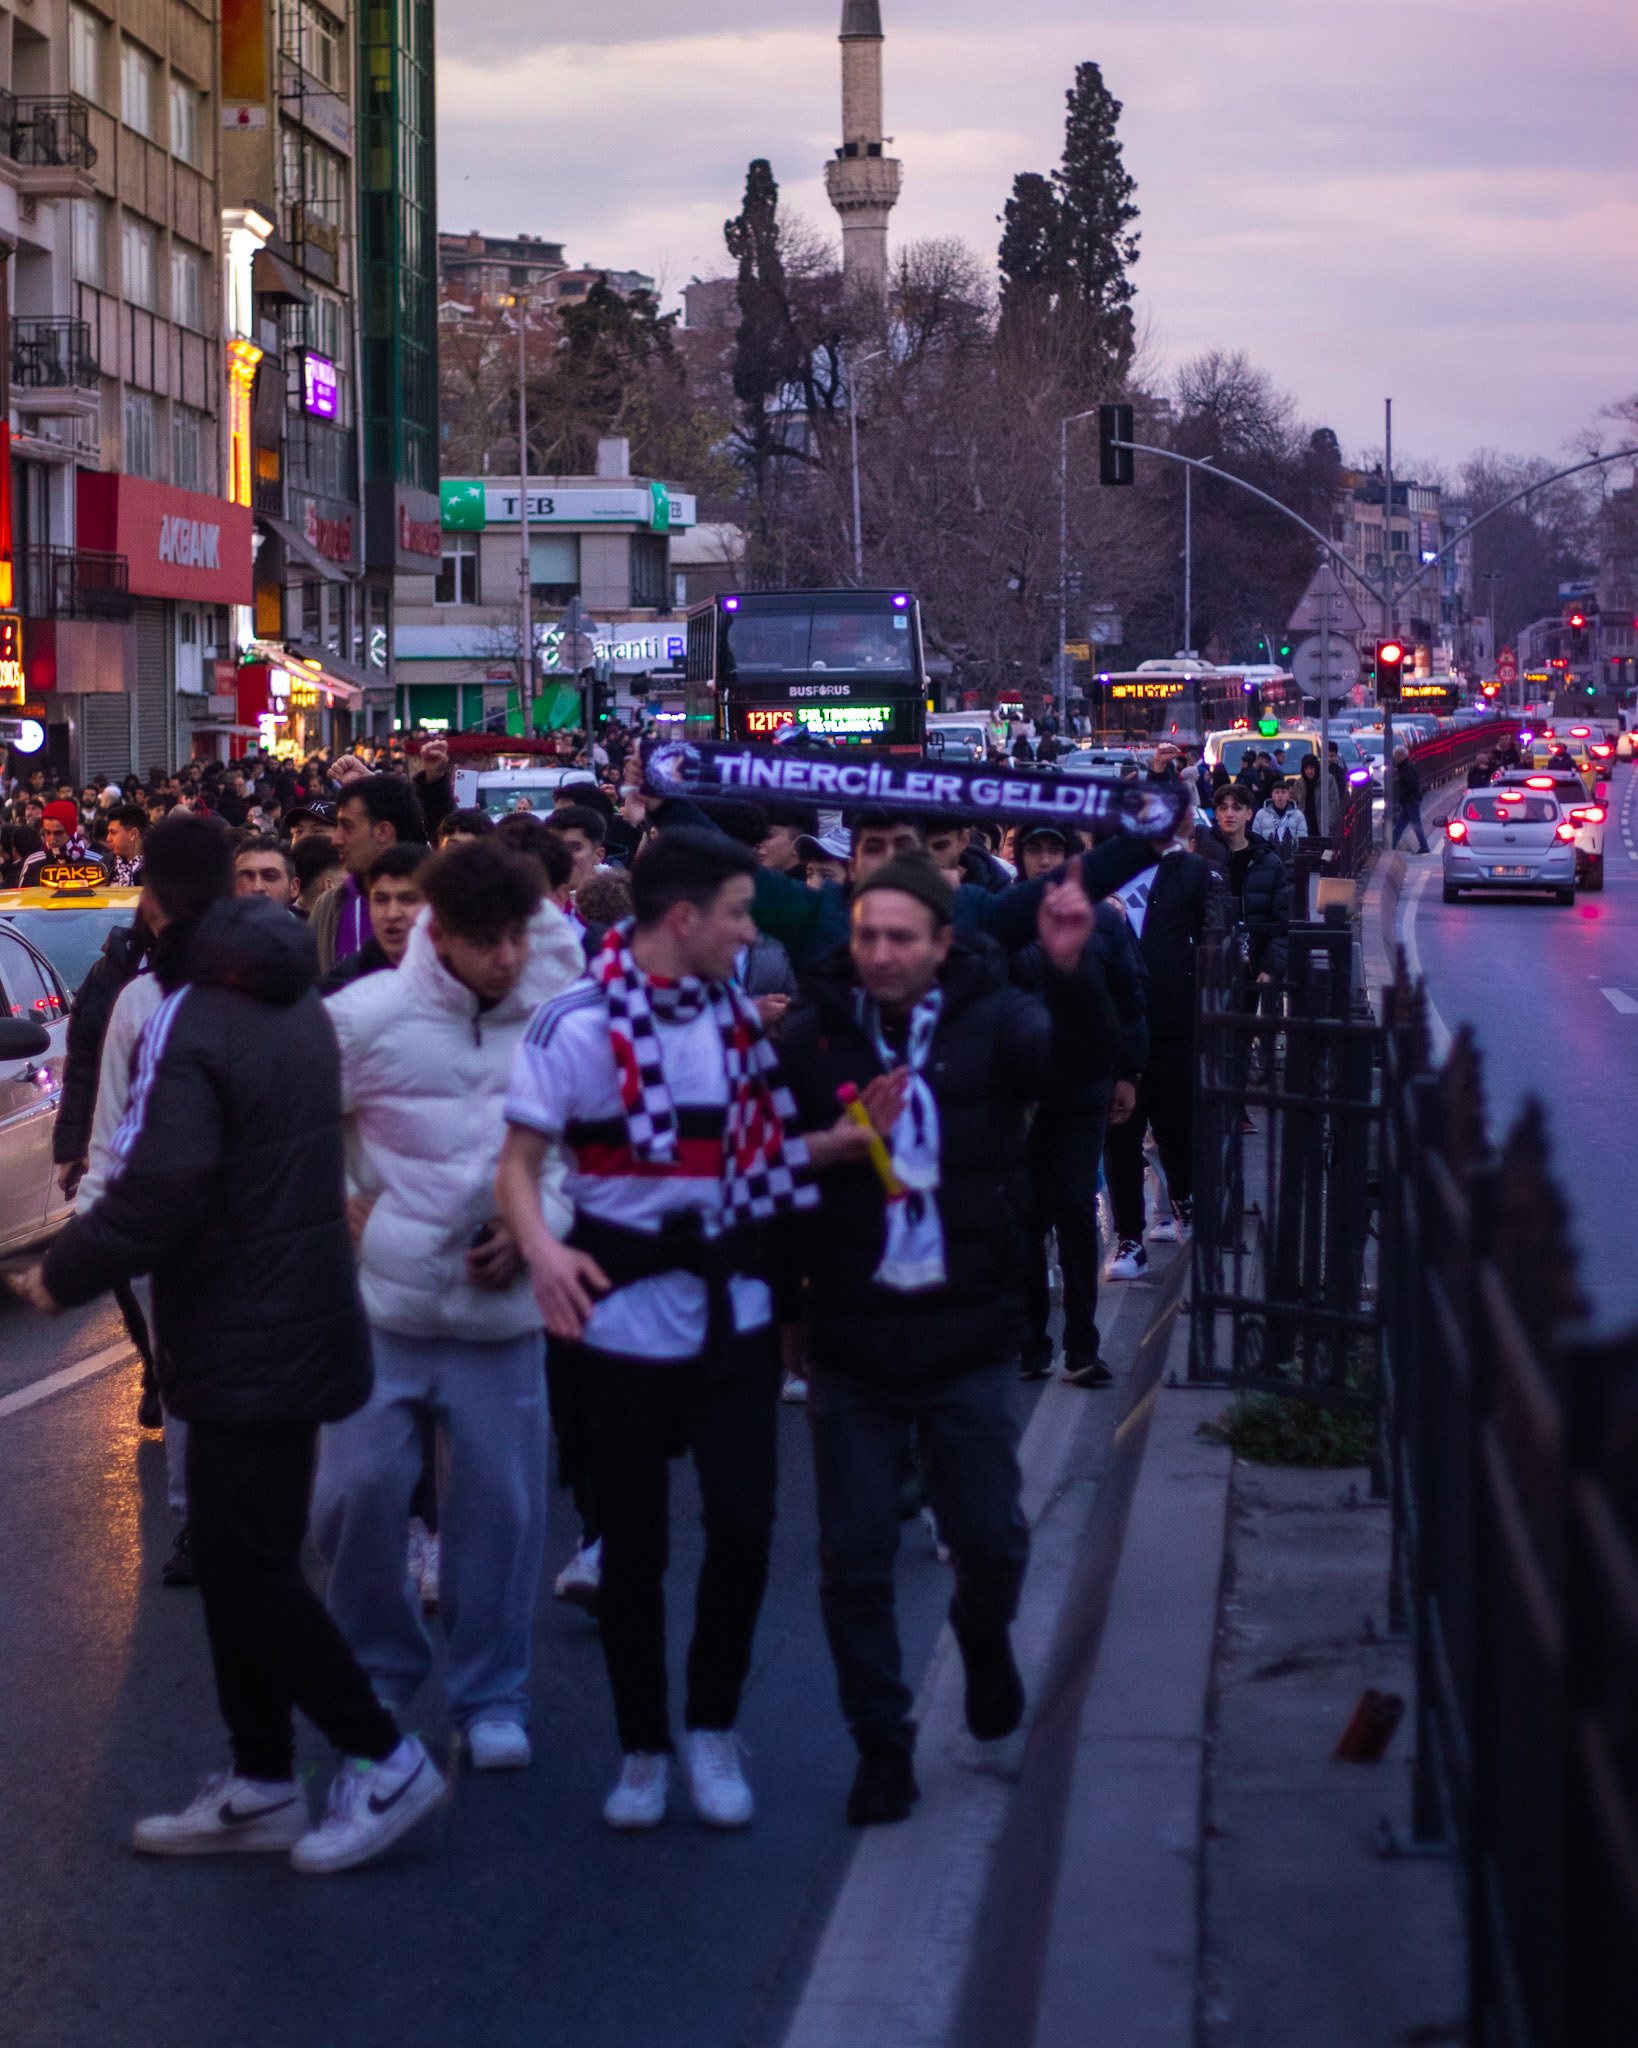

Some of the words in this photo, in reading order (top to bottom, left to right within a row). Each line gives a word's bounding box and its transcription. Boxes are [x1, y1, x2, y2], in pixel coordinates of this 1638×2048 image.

[503, 497, 555, 516] TEB
[669, 501, 682, 518] EB
[159, 513, 221, 570] AKBANK
[595, 637, 659, 660] aranti
[788, 685, 851, 697] BUSFORUS
